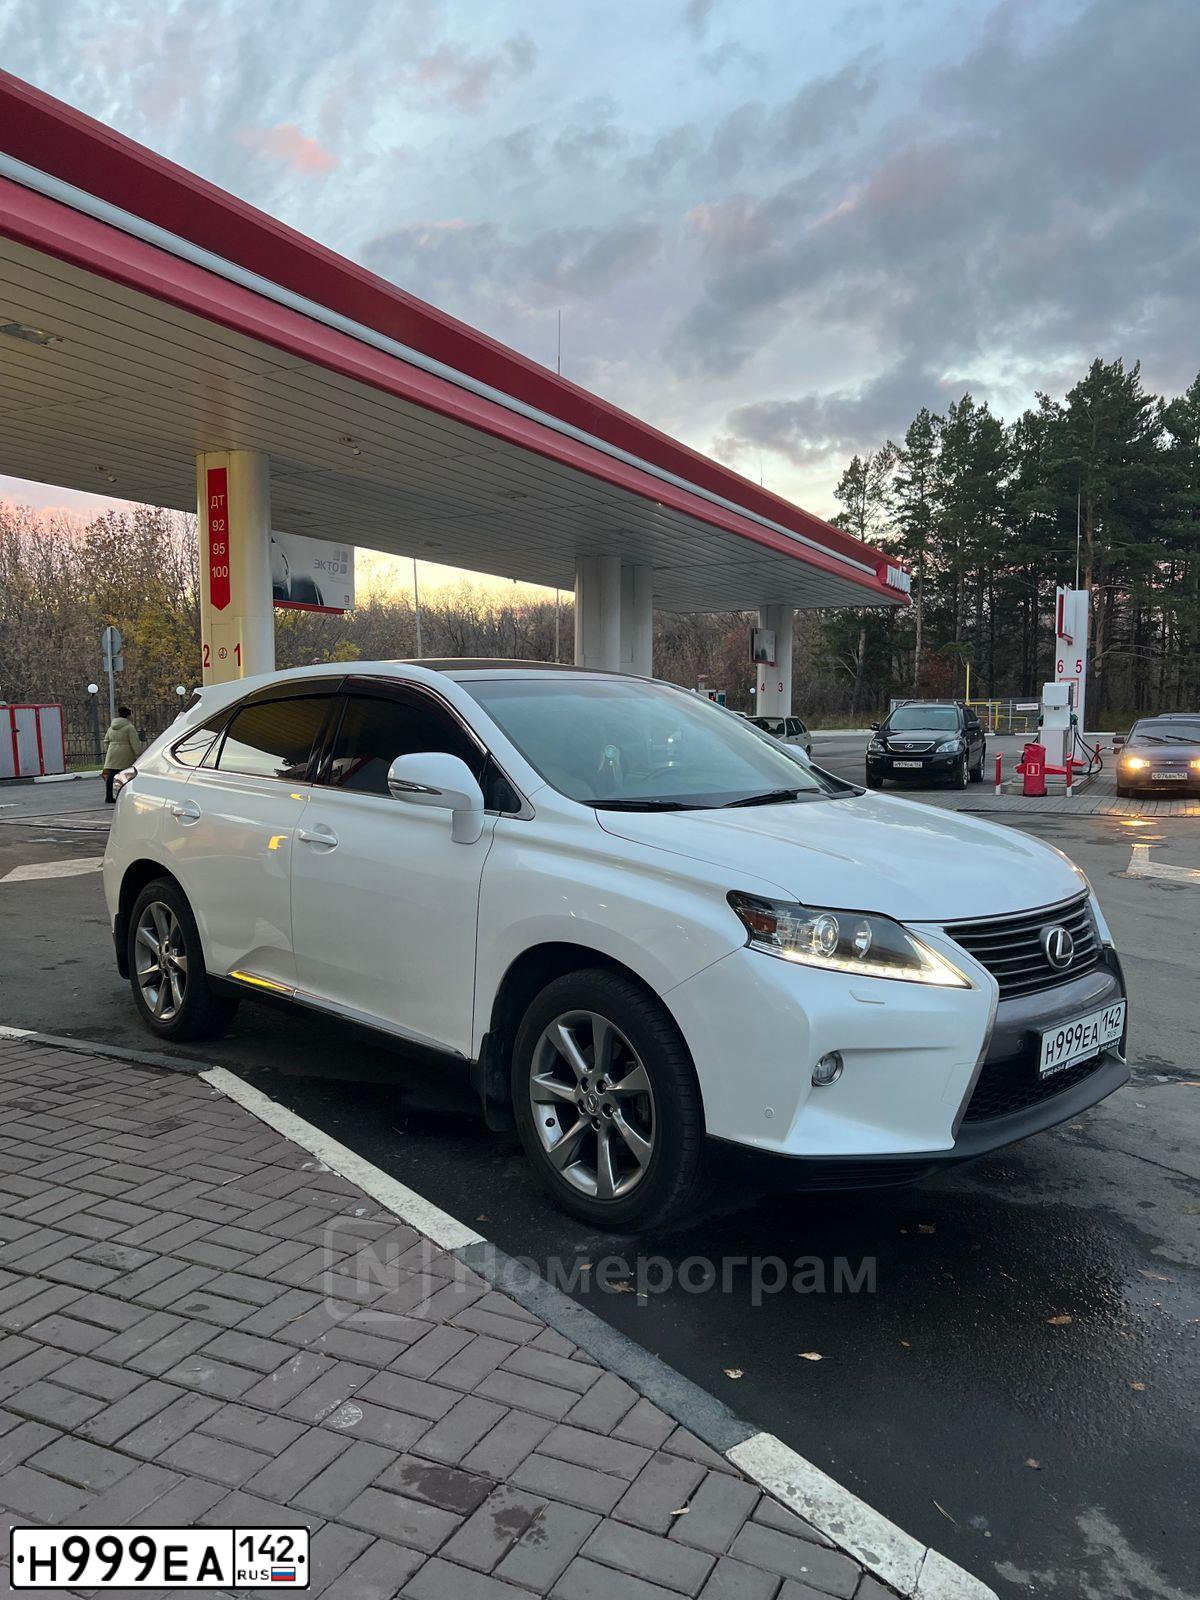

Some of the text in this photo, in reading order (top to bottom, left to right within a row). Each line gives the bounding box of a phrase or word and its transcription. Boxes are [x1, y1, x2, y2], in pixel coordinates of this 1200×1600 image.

[211, 494, 225, 509] ДТ
[212, 519, 225, 532] 92
[212, 542, 226, 555] 95
[211, 565, 229, 578] 100
[313, 558, 340, 573] ЭКТО
[203, 643, 211, 668] 2
[233, 643, 241, 667] 1
[1057, 659, 1064, 674] 6
[1075, 659, 1083, 674] 5
[760, 682, 766, 692] 4
[778, 681, 784, 693] 3
[1045, 1022, 1098, 1065] Н999ЕА
[1102, 1006, 1122, 1032] 142
[1107, 1028, 1118, 1039] RUS
